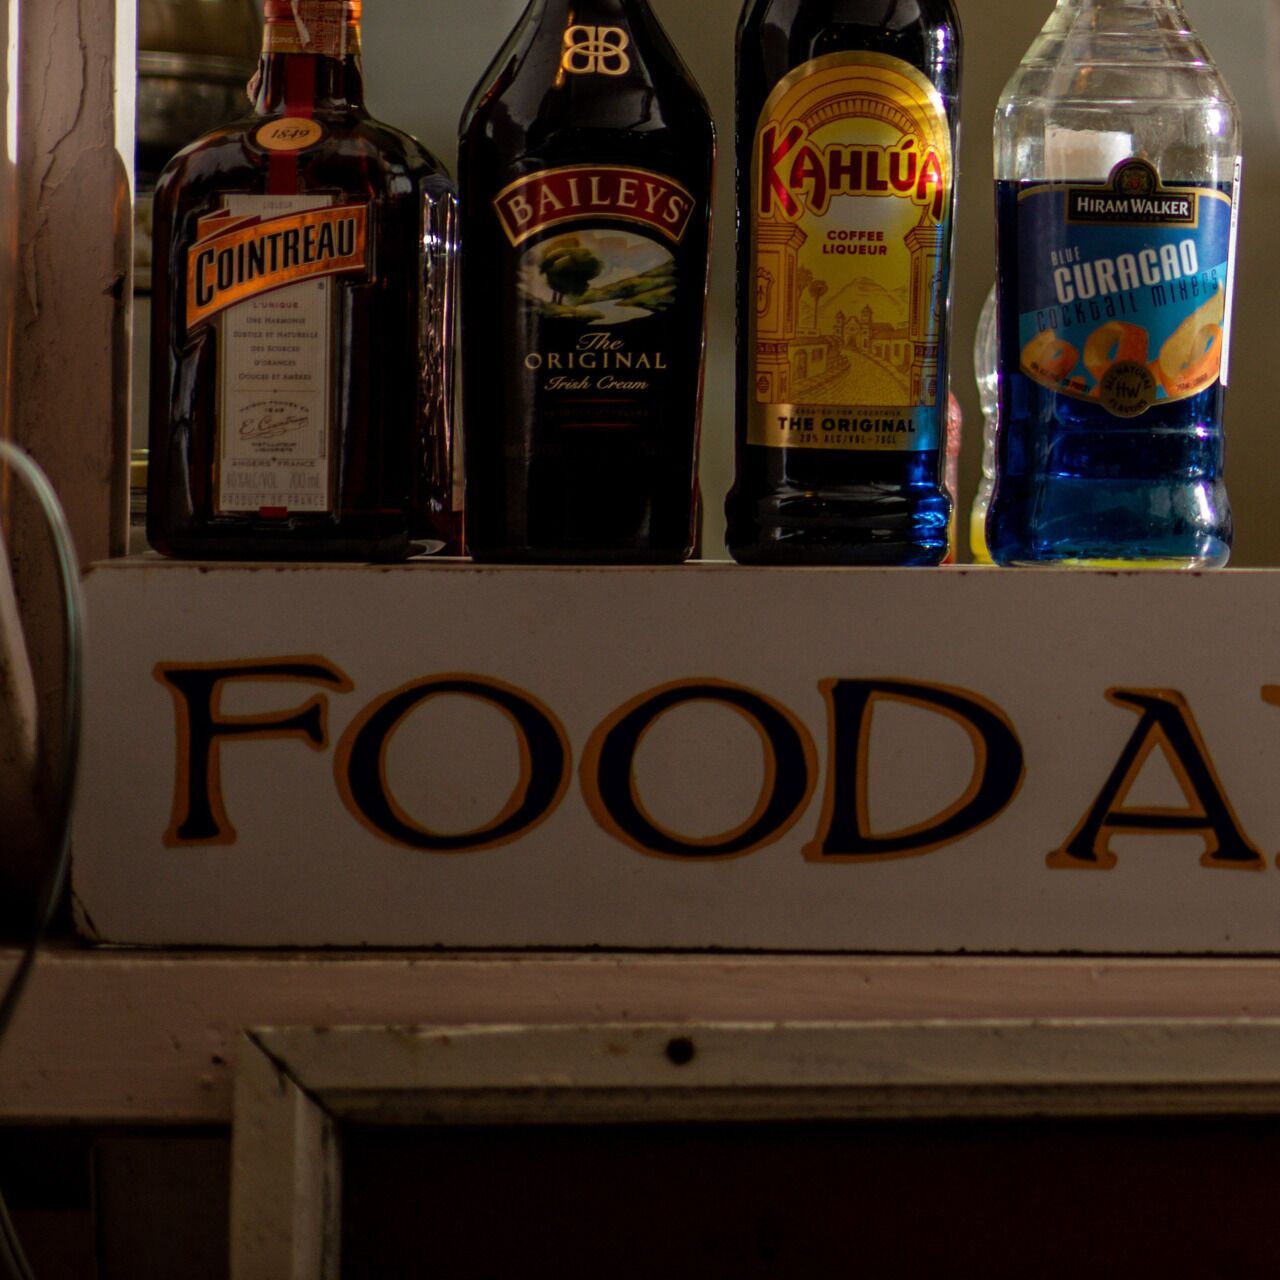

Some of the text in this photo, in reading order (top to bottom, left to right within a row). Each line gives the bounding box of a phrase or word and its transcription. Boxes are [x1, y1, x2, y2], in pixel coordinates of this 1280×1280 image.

[270, 128, 311, 140] 1849
[761, 124, 943, 221] KAHLÚA
[506, 175, 685, 228] BAILEYS
[1077, 195, 1189, 217] HIRAM WALKER
[827, 230, 884, 241] COFFEE
[822, 244, 888, 256] LIQUEUR
[1050, 245, 1081, 267] BLUE
[196, 218, 355, 308] COINTREAU
[1053, 238, 1199, 305] CURACAO
[575, 332, 625, 351] The
[524, 351, 668, 370] ORIGINAL
[543, 375, 650, 392] Irish Cream
[777, 416, 916, 433] THE ORIGINAL
[222, 495, 266, 506] PRODUCT
[287, 495, 325, 506] FRANCE
[154, 655, 1027, 865] FOOD
